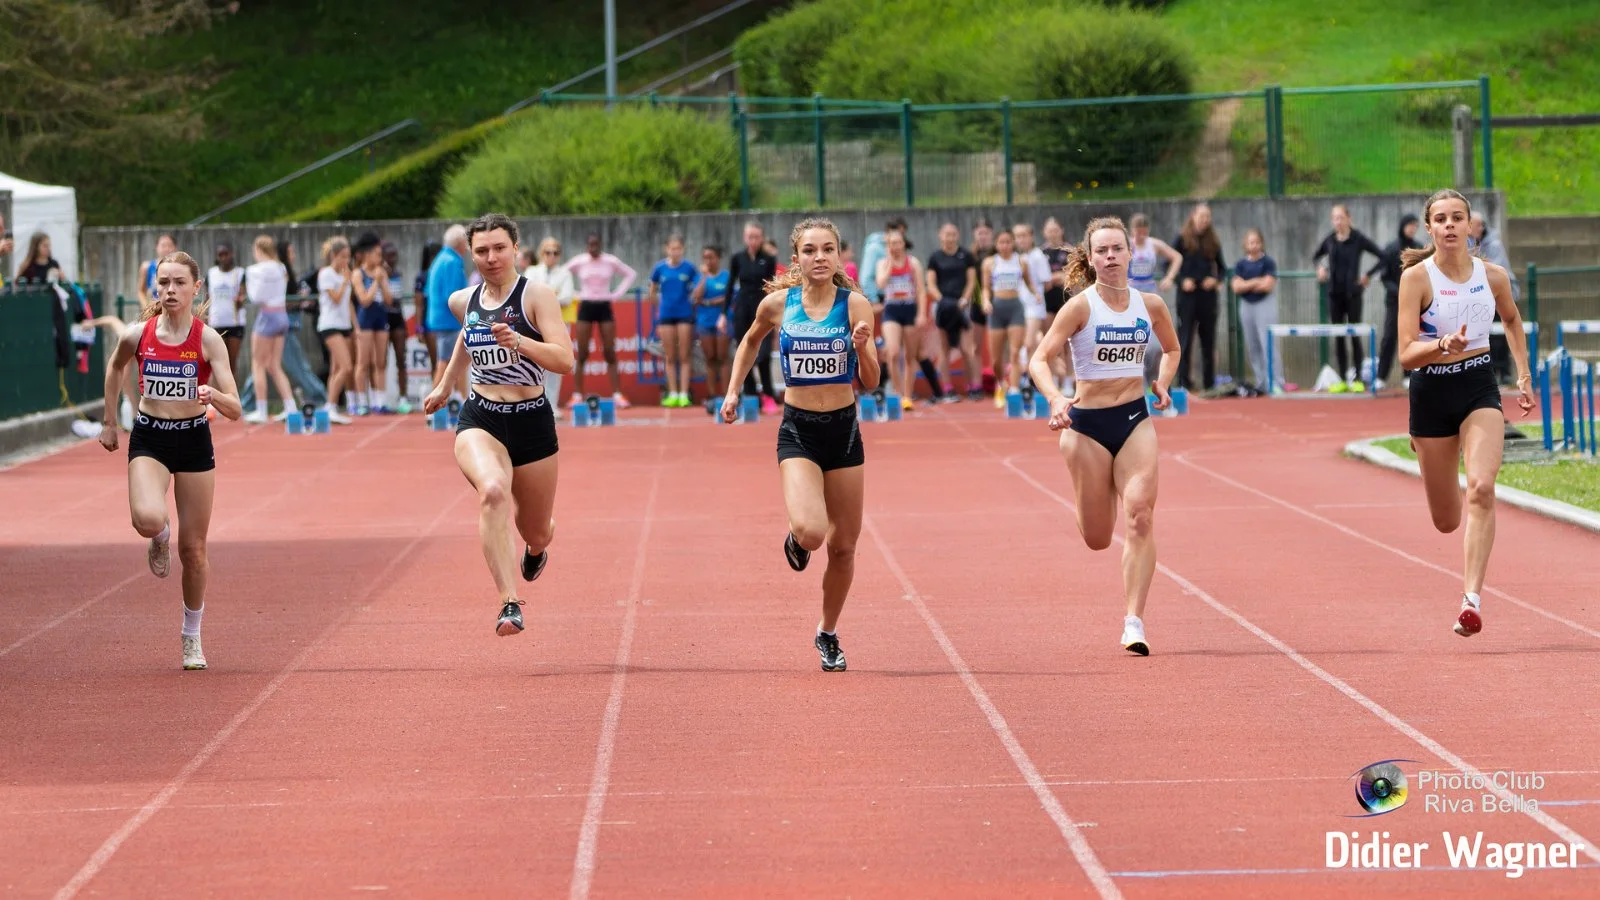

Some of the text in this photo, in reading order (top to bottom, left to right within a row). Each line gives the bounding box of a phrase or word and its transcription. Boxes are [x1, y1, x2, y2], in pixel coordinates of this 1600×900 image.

[1448, 303, 1491, 329] 7188
[786, 323, 846, 335] EXCELSIOR
[1099, 331, 1133, 341] Allianz
[792, 341, 830, 351] Allianz
[472, 348, 507, 366] 6010
[1097, 347, 1136, 363] 6648
[145, 363, 180, 374] Allianz
[794, 358, 836, 374] 7098
[1426, 354, 1491, 375] NIKE PRO
[146, 379, 186, 397] 7025
[478, 398, 513, 413] NIKE
[515, 397, 545, 413] PRO
[152, 420, 191, 430] NIKE
